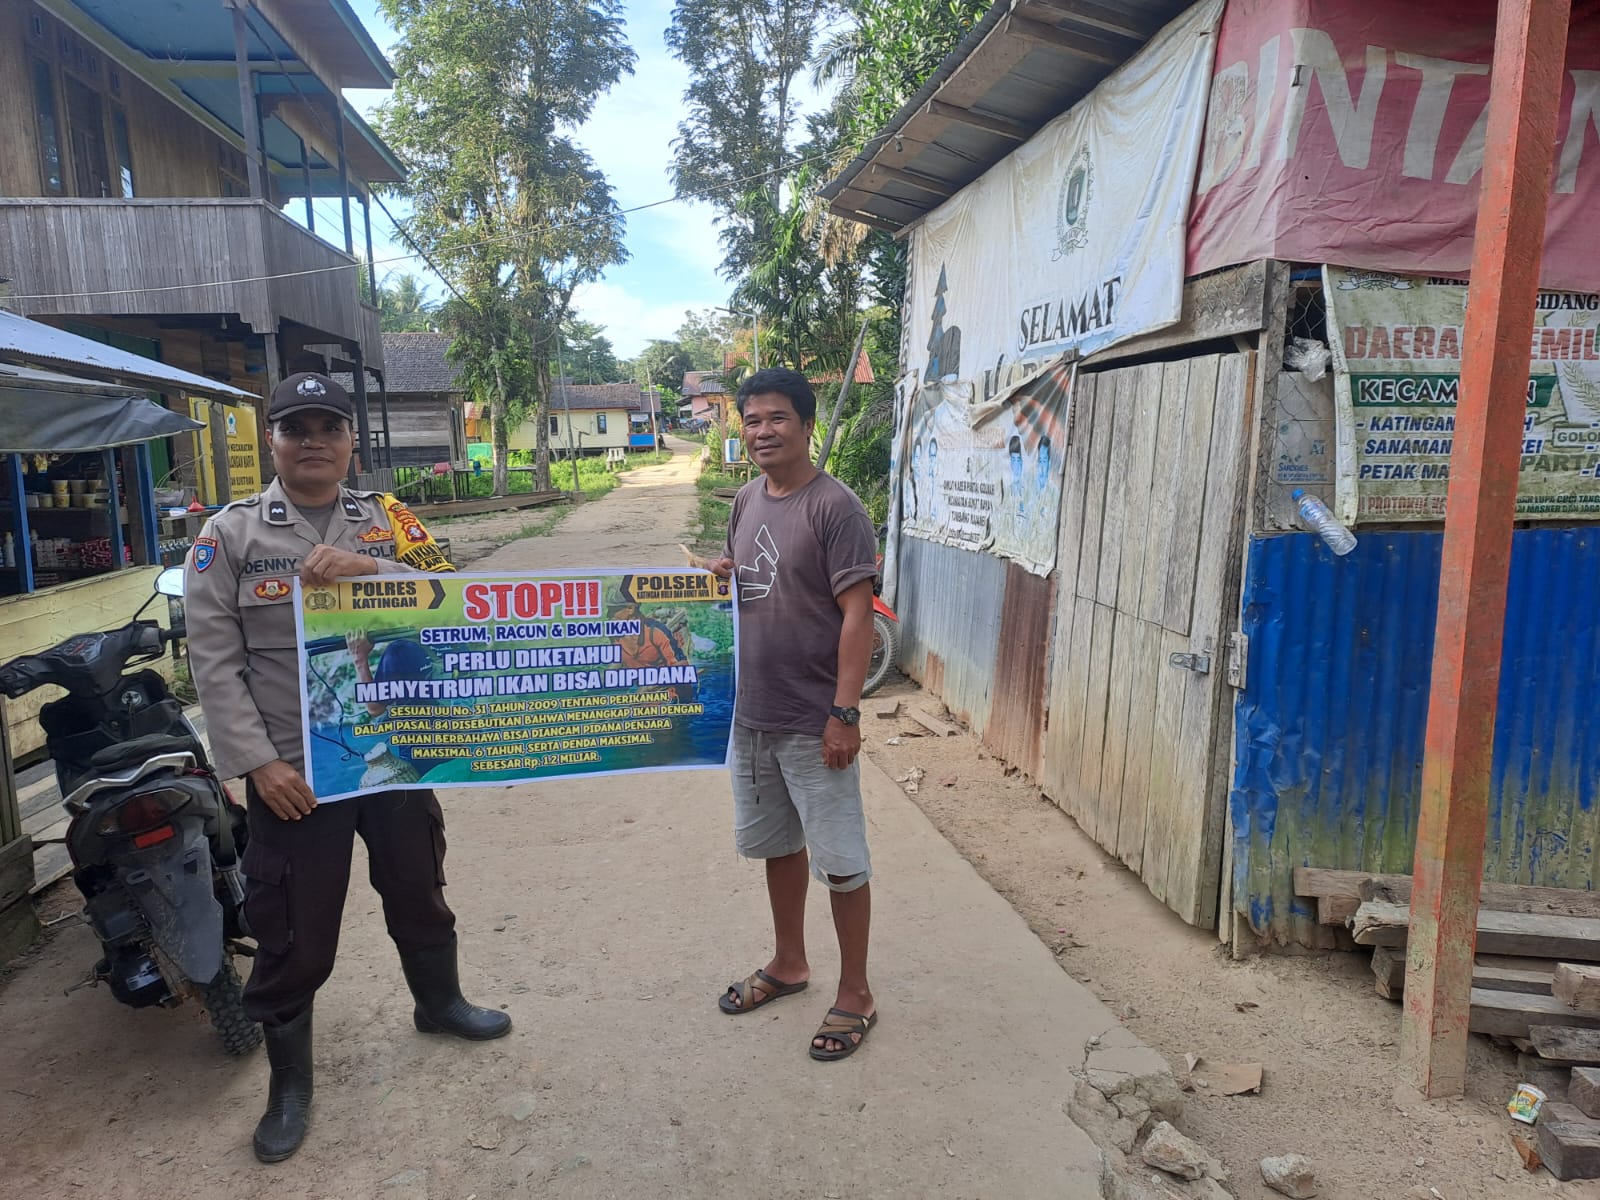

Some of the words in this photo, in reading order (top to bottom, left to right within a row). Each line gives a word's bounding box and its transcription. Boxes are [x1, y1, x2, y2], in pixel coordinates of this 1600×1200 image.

[1018, 276, 1121, 353] SELAMAT
[1343, 326, 1460, 359] DAERA
[1557, 432, 1600, 443] GOLO
[1360, 465, 1417, 479] PETAK
[245, 557, 297, 574] DENNY
[352, 582, 416, 596] POLRES
[637, 575, 707, 590] POLSEK
[352, 597, 417, 609] KATINGAN
[466, 581, 600, 620] STOP!!!
[421, 629, 491, 643] SETRUM,
[496, 625, 546, 640] RACUN
[552, 624, 562, 636] &
[568, 623, 600, 636] BOM
[606, 621, 640, 634] IKAN
[445, 651, 511, 671] PERLU
[516, 646, 620, 668] DIKETAHUI
[356, 677, 493, 702] MENYETRUM
[498, 674, 548, 695] IKAN
[553, 670, 601, 691] BISA
[605, 666, 697, 687] DIPIDANA
[390, 706, 431, 716] SESUAI
[435, 706, 449, 716] UU
[453, 706, 472, 716] No.
[475, 705, 486, 714] 31
[490, 702, 525, 713] TAHUN
[528, 700, 558, 711] 2009
[560, 697, 606, 708] TENTANG
[354, 723, 393, 736] DALAM
[396, 720, 432, 731] PASAL
[435, 720, 449, 729] 84
[452, 716, 521, 730] DISEBUTKAN
[524, 713, 564, 725] BAHWA
[566, 708, 630, 721] MENANGKAP
[632, 706, 659, 716] IKAN
[661, 704, 702, 715] DENGAN
[391, 734, 431, 745] BAHAN
[435, 732, 500, 744] BERBAHAYA
[503, 730, 529, 740] BISA
[531, 726, 580, 738] DIANCAM
[583, 723, 622, 733] PIDANA
[624, 719, 671, 730] PENJARA
[413, 747, 472, 759] MAKSIMAL
[475, 747, 484, 757] 6
[486, 744, 525, 756] TAHUN,
[528, 741, 559, 753] SERTA
[562, 738, 597, 749] DENDA
[472, 759, 521, 770] SEBESAR
[525, 758, 542, 769] Rp.
